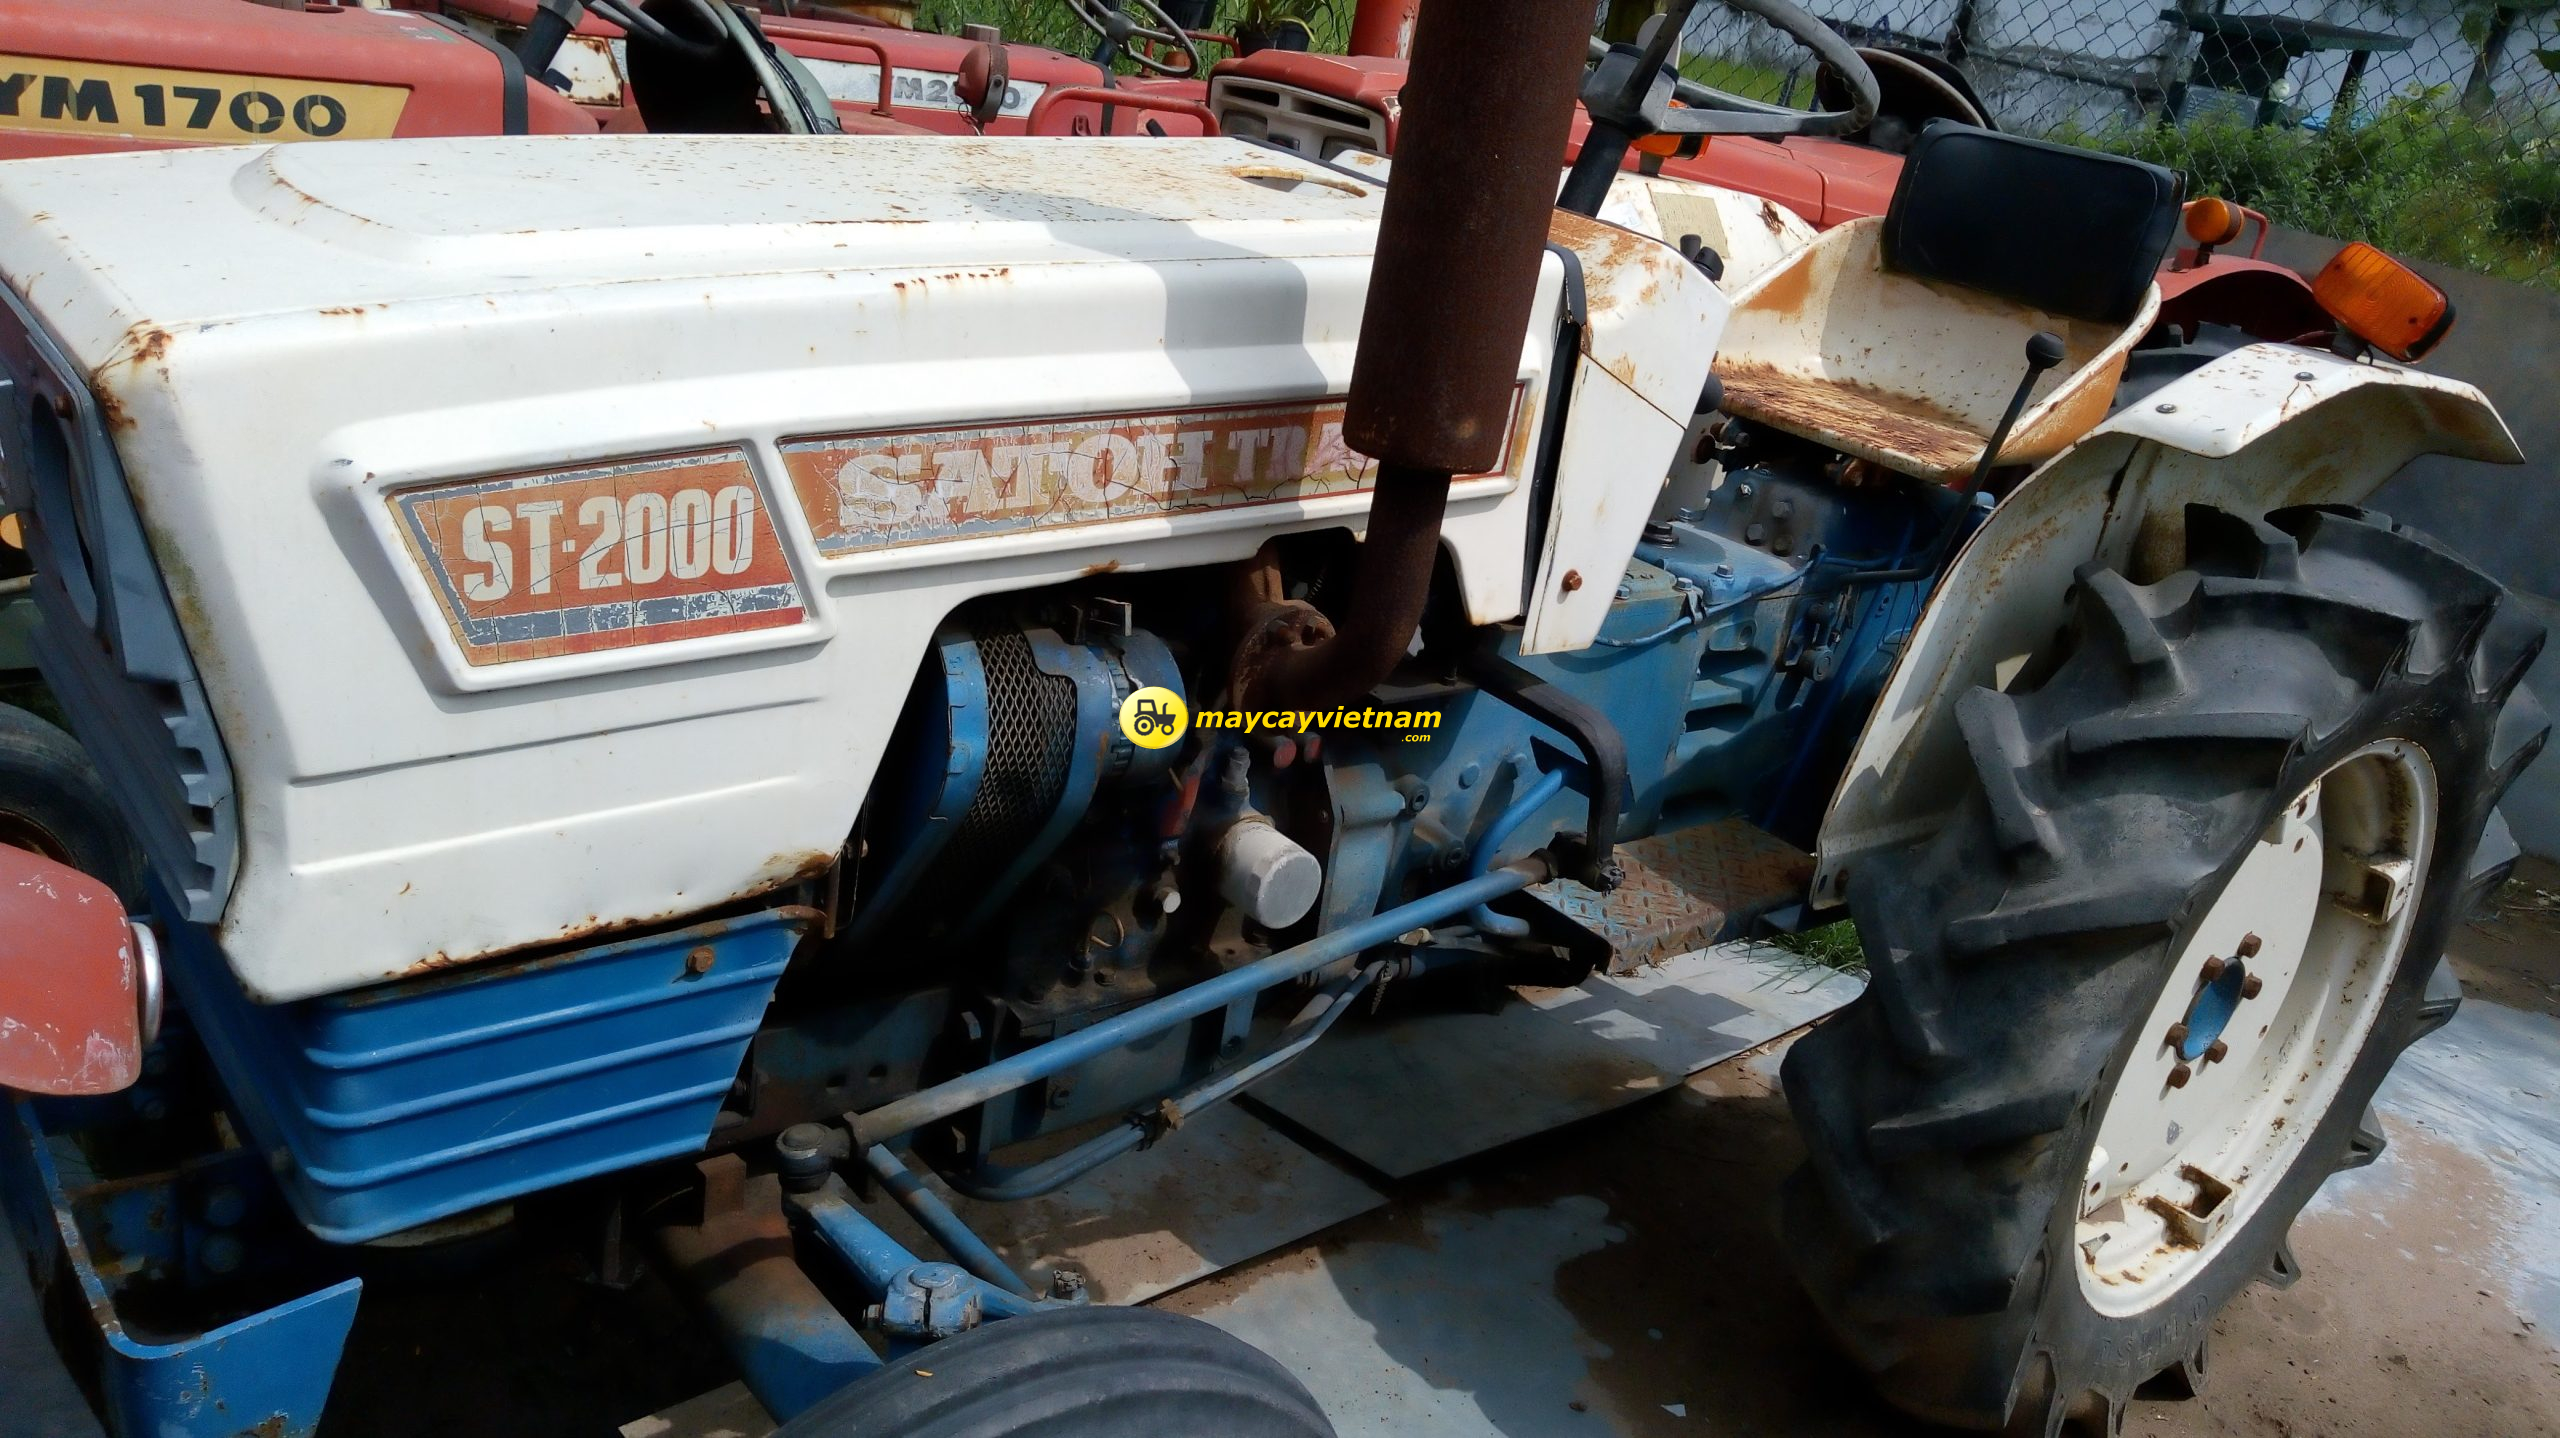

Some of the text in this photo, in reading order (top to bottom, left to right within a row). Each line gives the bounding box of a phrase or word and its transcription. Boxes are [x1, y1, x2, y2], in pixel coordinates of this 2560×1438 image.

[135, 83, 348, 137] 1700
[838, 430, 1215, 527] SATOH
[461, 485, 755, 602] ST-2000
